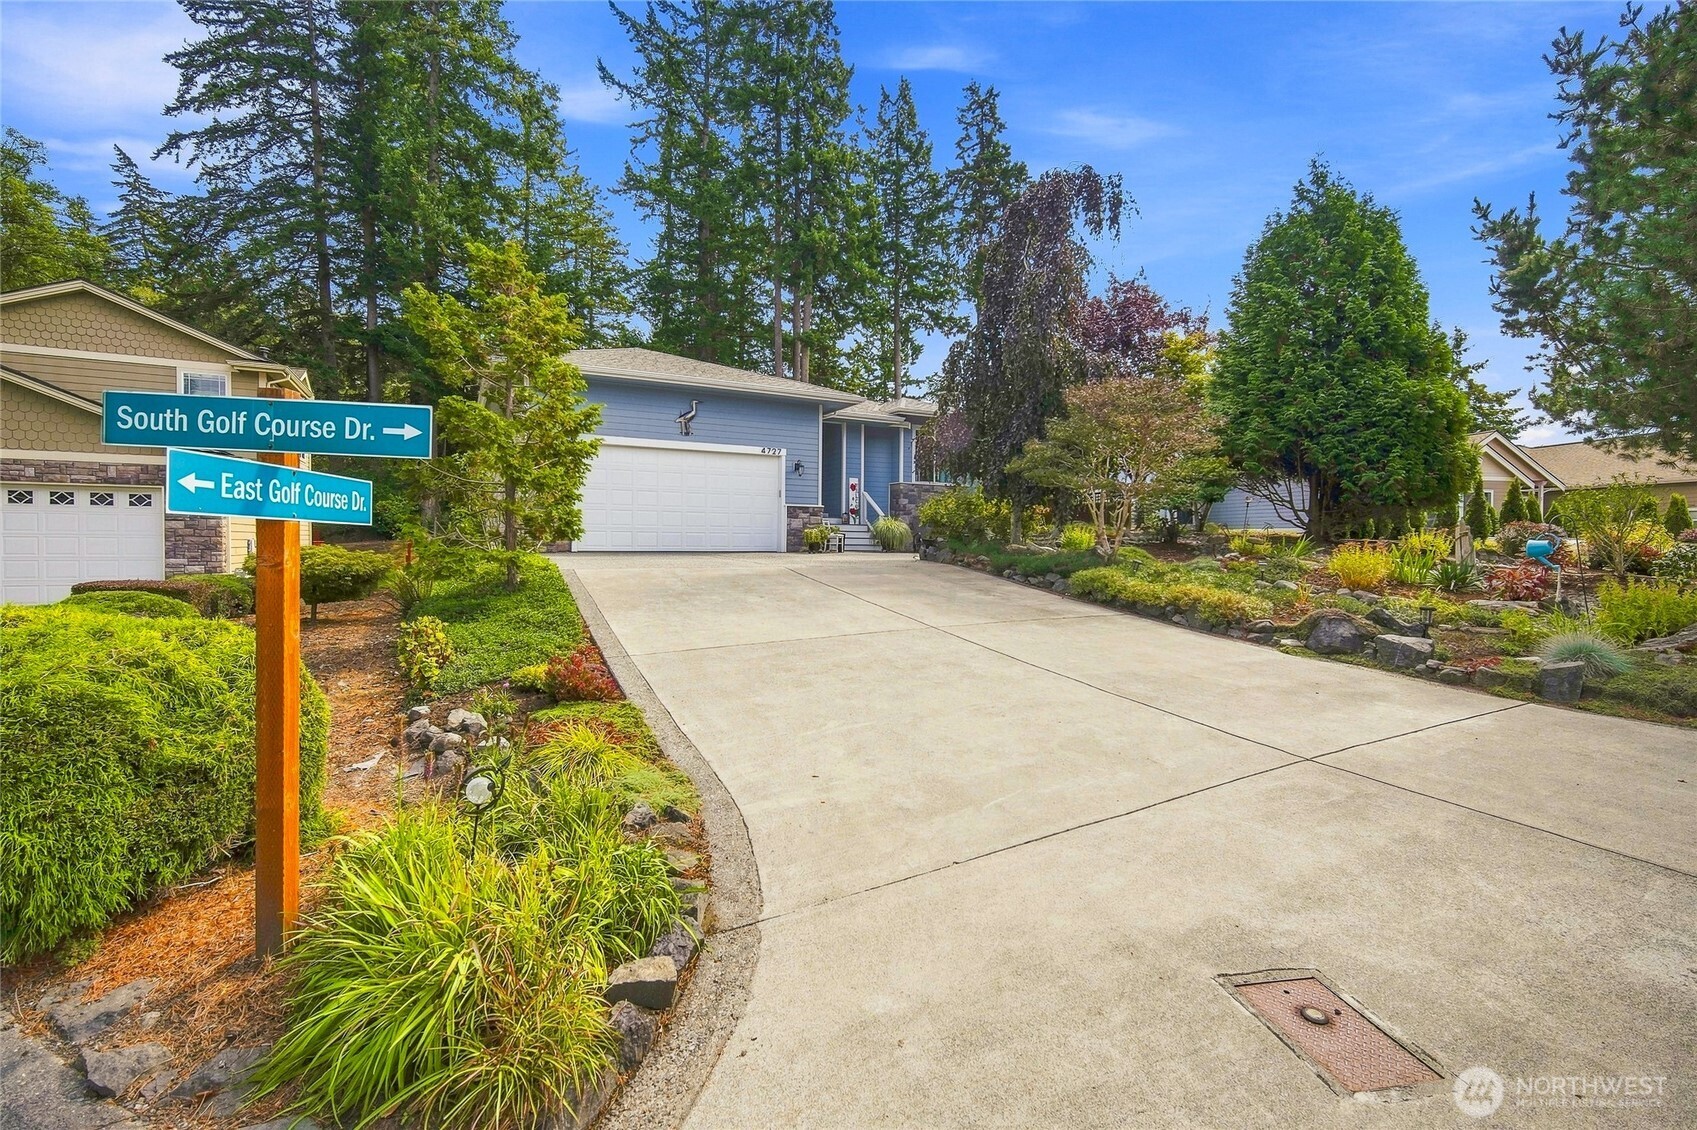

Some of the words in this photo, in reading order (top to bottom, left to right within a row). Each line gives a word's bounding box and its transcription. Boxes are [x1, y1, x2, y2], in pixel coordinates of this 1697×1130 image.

[116, 405, 188, 432] South
[198, 409, 247, 435] Golf
[254, 412, 336, 438] Course
[345, 417, 375, 440] Dr.
[761, 447, 782, 456] 4727
[221, 472, 263, 502] East
[268, 479, 301, 505] Golf
[304, 485, 348, 511] Course
[351, 492, 367, 511] Dr.
